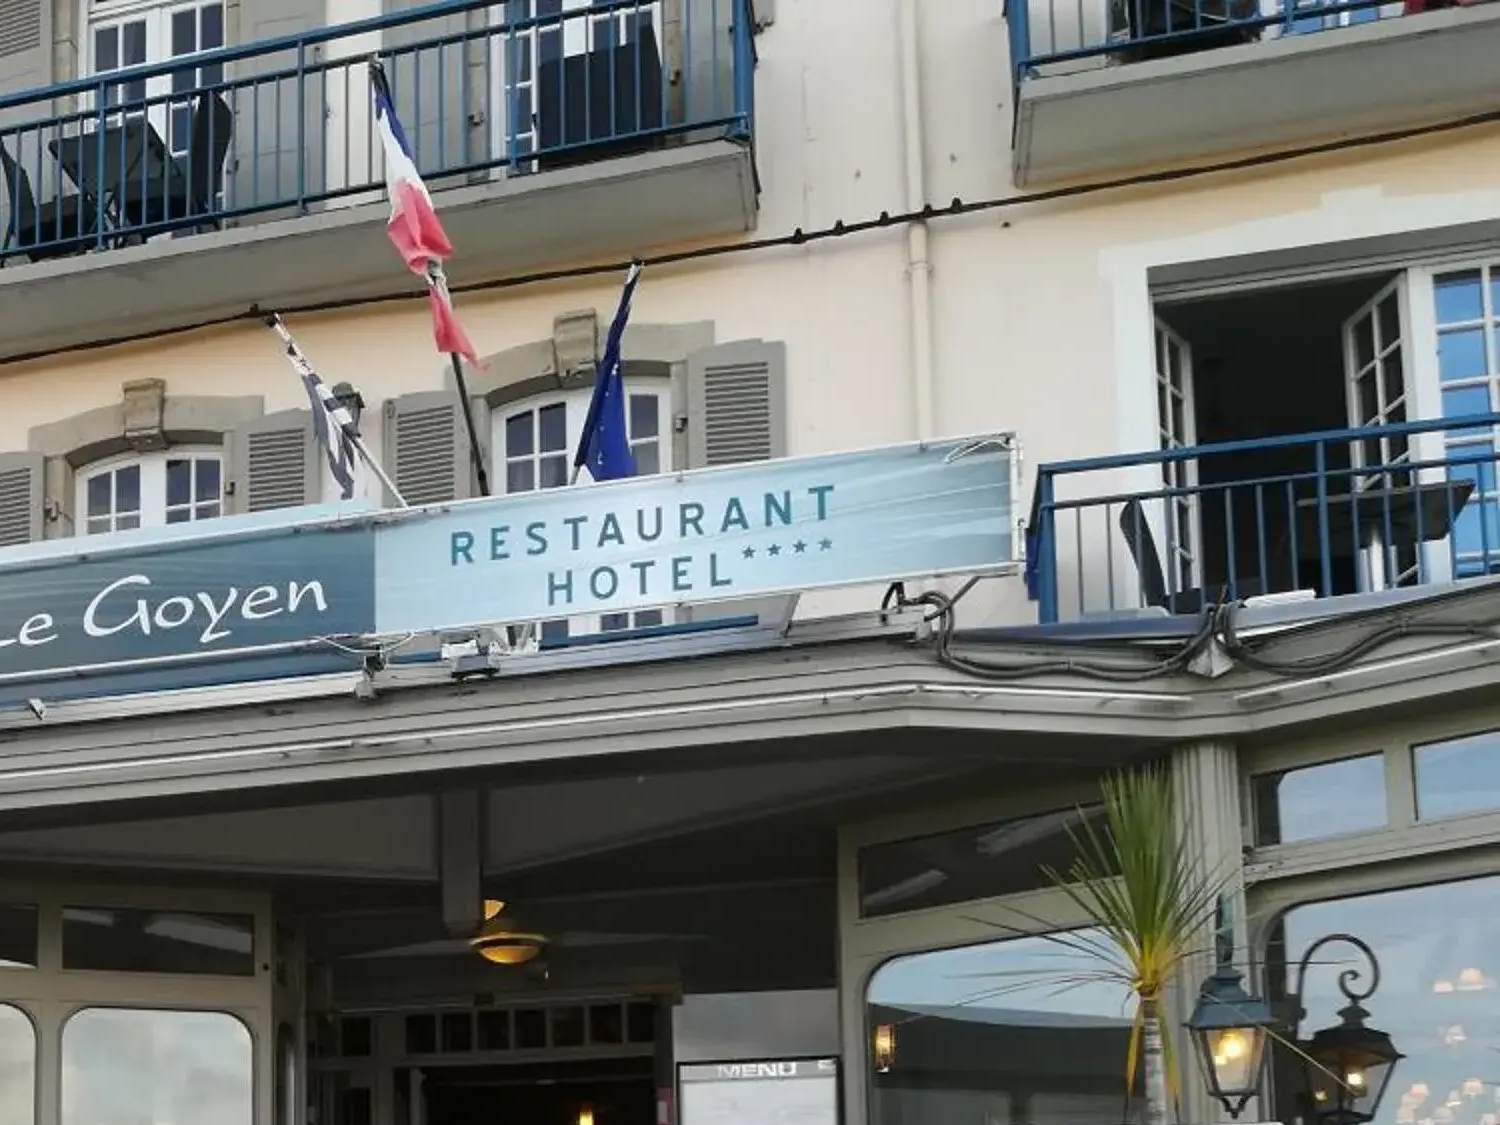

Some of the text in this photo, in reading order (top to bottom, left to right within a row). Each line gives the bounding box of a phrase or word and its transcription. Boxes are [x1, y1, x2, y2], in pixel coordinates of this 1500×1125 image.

[451, 485, 835, 566] RESTAURANT
[82, 574, 329, 644] Goyen
[547, 552, 733, 606] HOTEL
[717, 1061, 798, 1079] MENU
